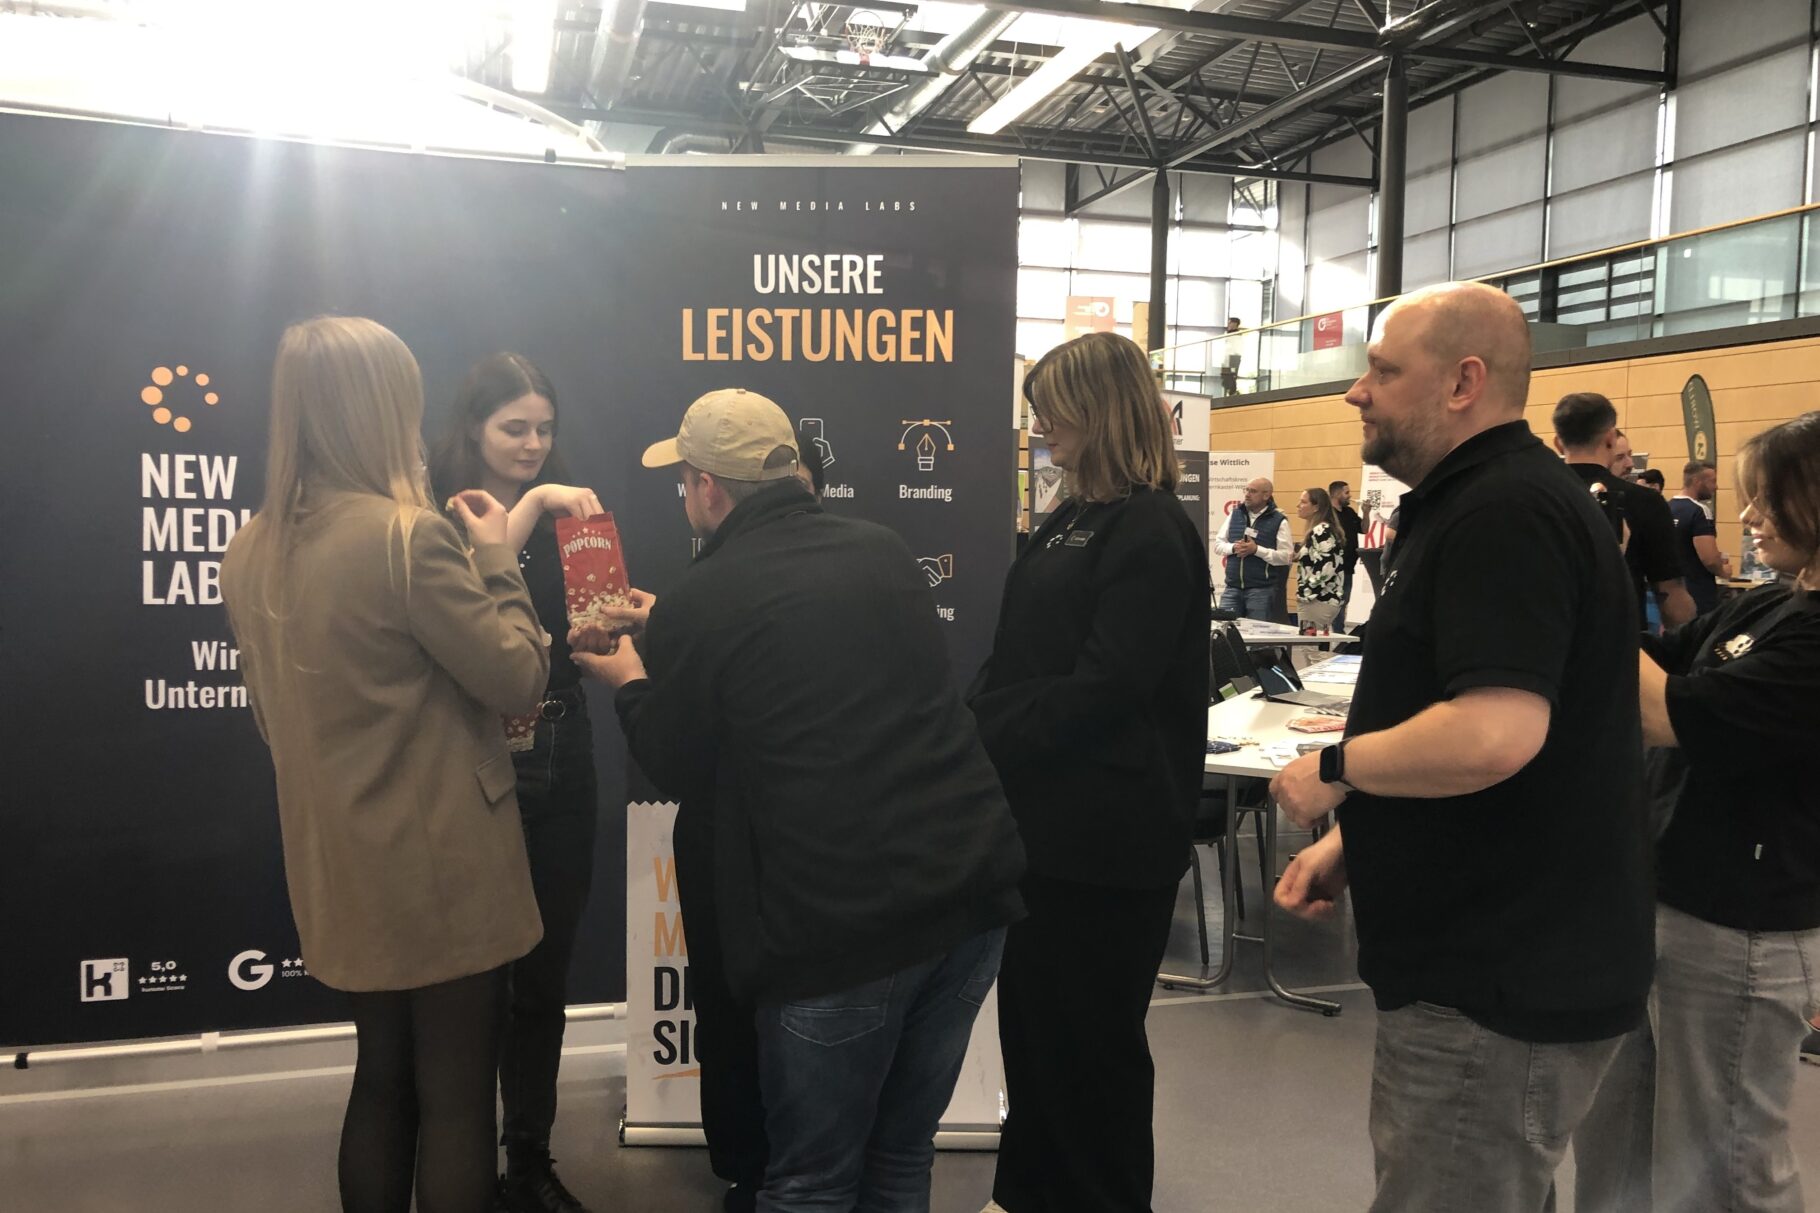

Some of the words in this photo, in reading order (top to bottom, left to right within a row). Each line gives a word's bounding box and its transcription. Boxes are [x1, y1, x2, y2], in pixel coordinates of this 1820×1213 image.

[722, 201, 758, 211] NEW
[780, 201, 844, 211] MEDIA
[865, 201, 916, 211] LABS
[753, 254, 884, 294] UNSERE
[682, 308, 954, 363] LEISTUNGEN
[142, 453, 238, 500] NEW
[899, 484, 953, 502] Branding
[563, 536, 612, 558] POPCORN
[191, 641, 241, 671] Wir
[151, 960, 177, 972] 5,0
